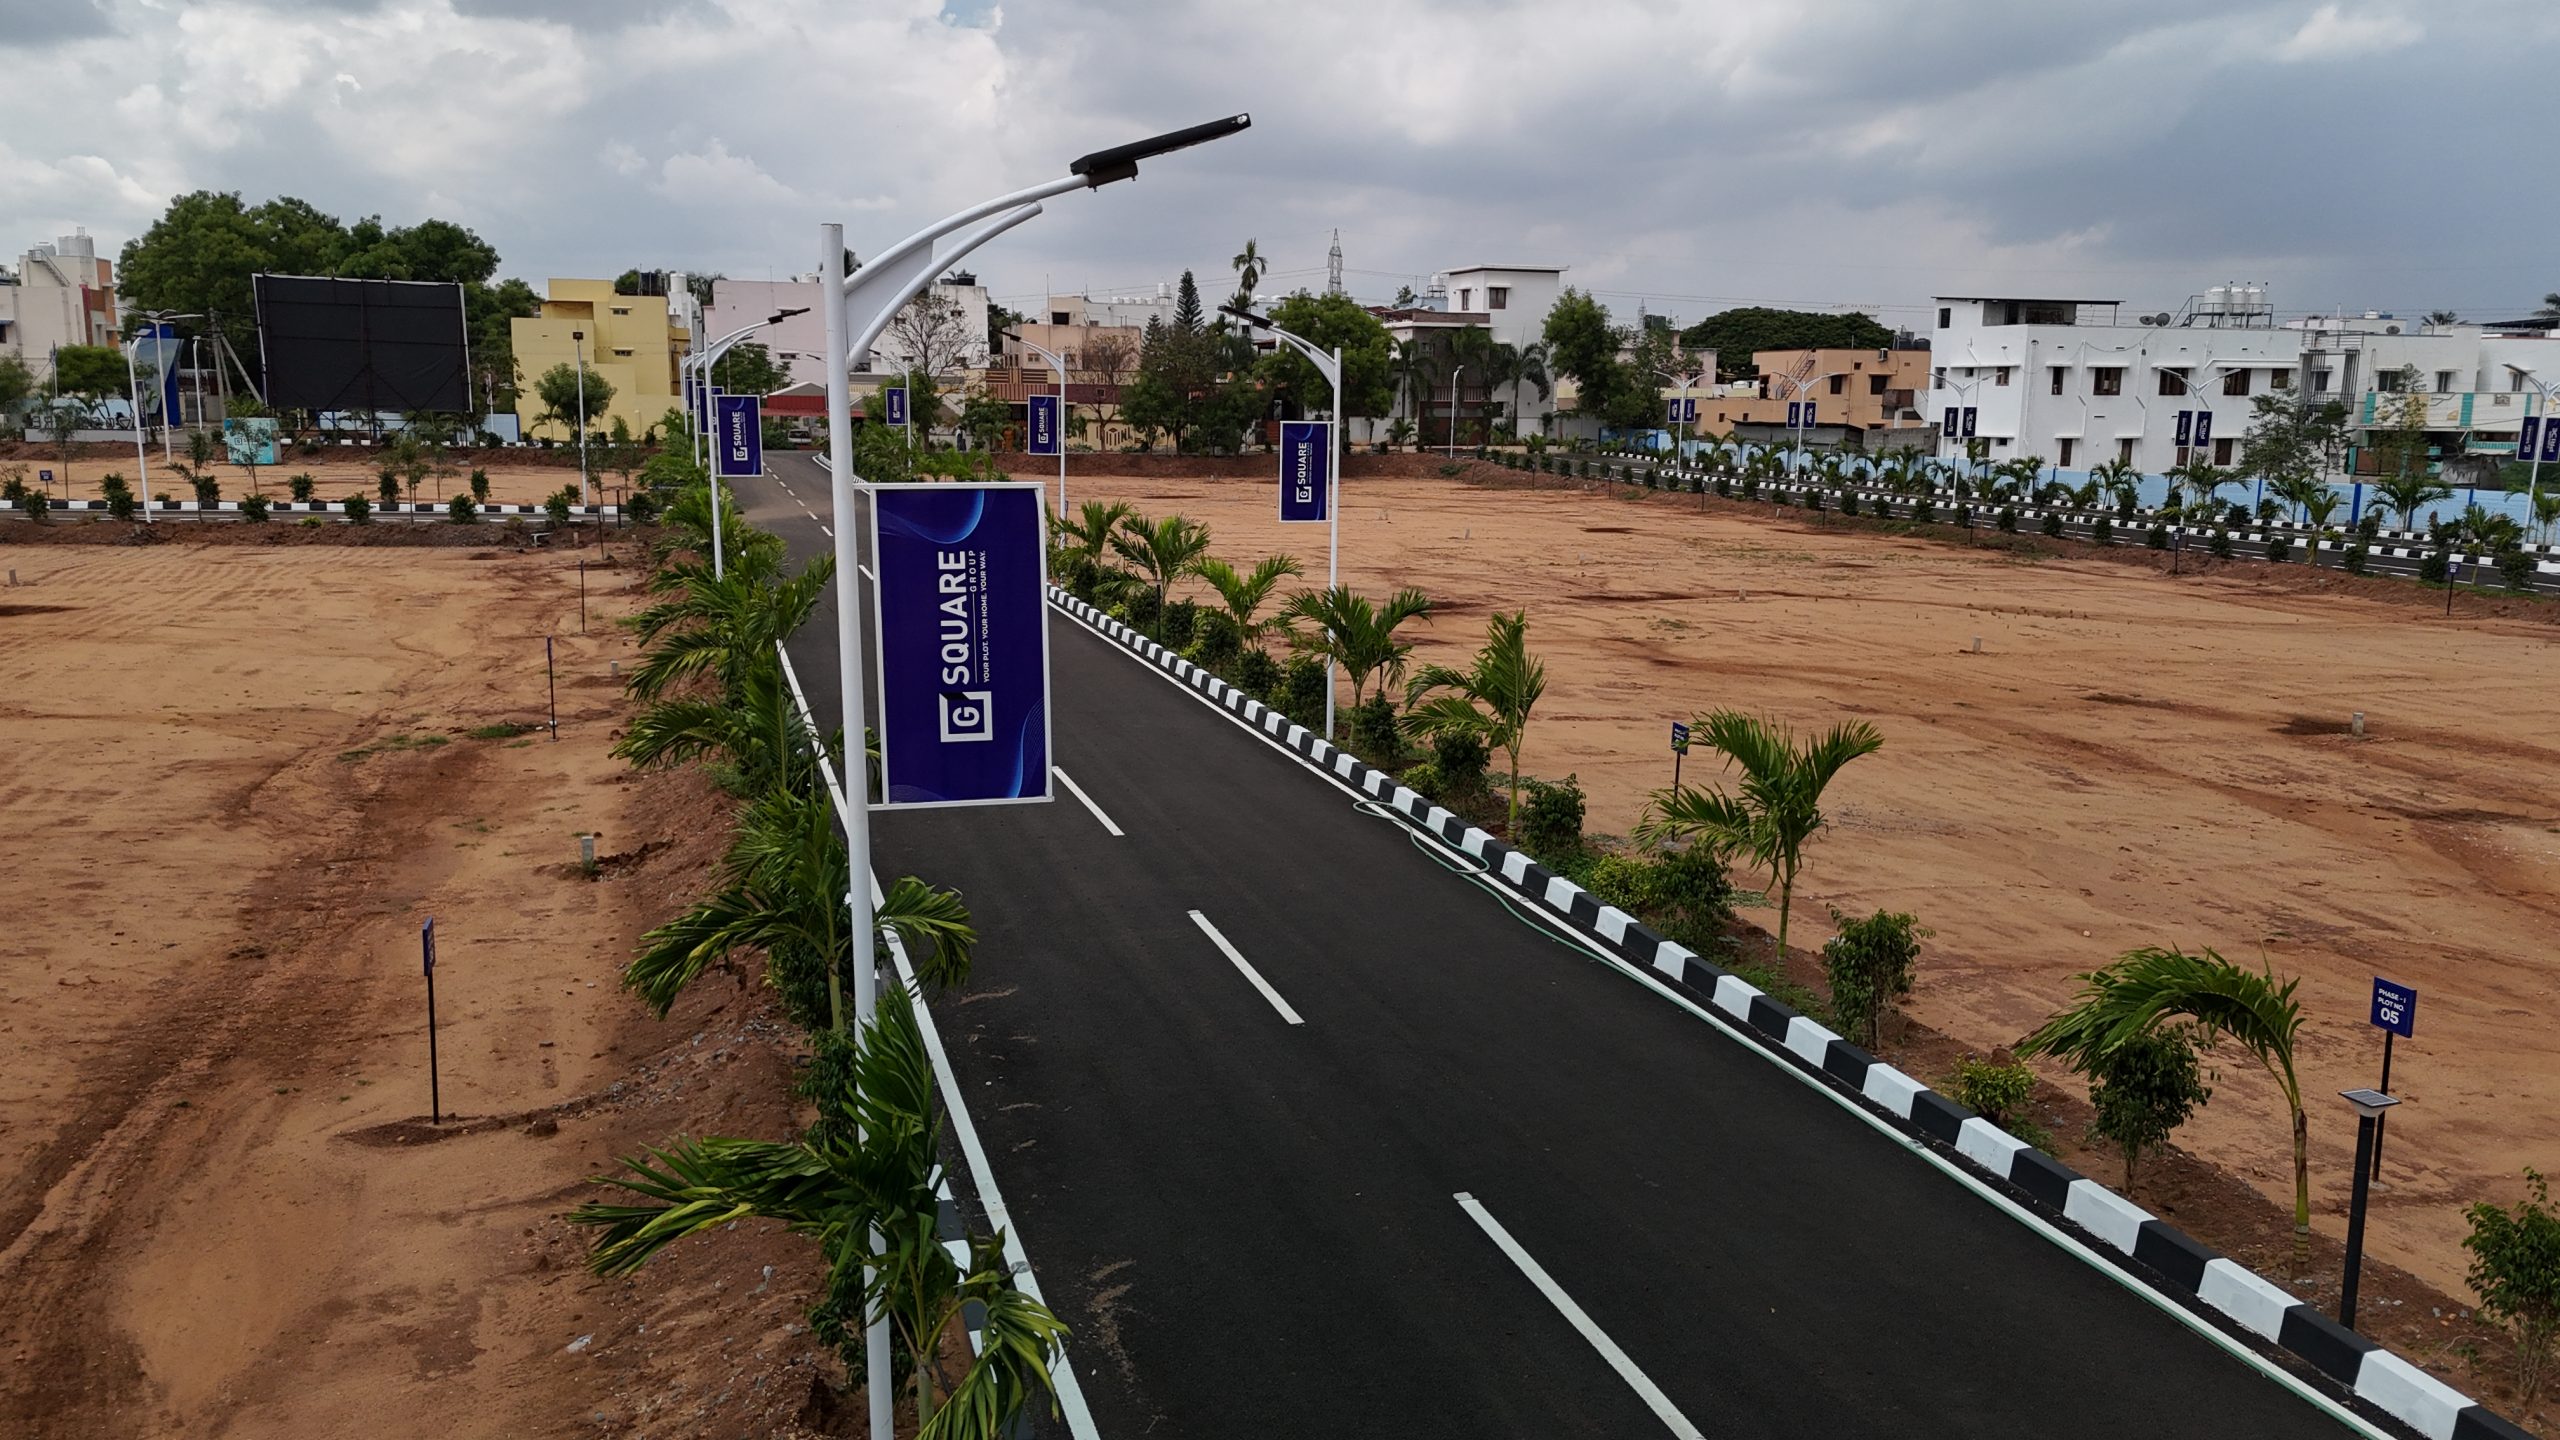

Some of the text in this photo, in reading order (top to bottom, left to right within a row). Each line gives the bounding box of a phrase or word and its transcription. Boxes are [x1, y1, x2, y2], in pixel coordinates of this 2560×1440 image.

[732, 411, 742, 447] SQUARE
[1297, 442, 1309, 498] G SQUARE
[968, 550, 977, 592] GROUP
[938, 550, 980, 727] G SQUARE
[981, 619, 989, 640] YOUR
[982, 641, 990, 660] PLOT.
[982, 662, 990, 683] YOUR
[2377, 996, 2405, 1012] PLOT NO.
[2378, 988, 2399, 1001] PHASE
[2380, 1007, 2399, 1025] 05
